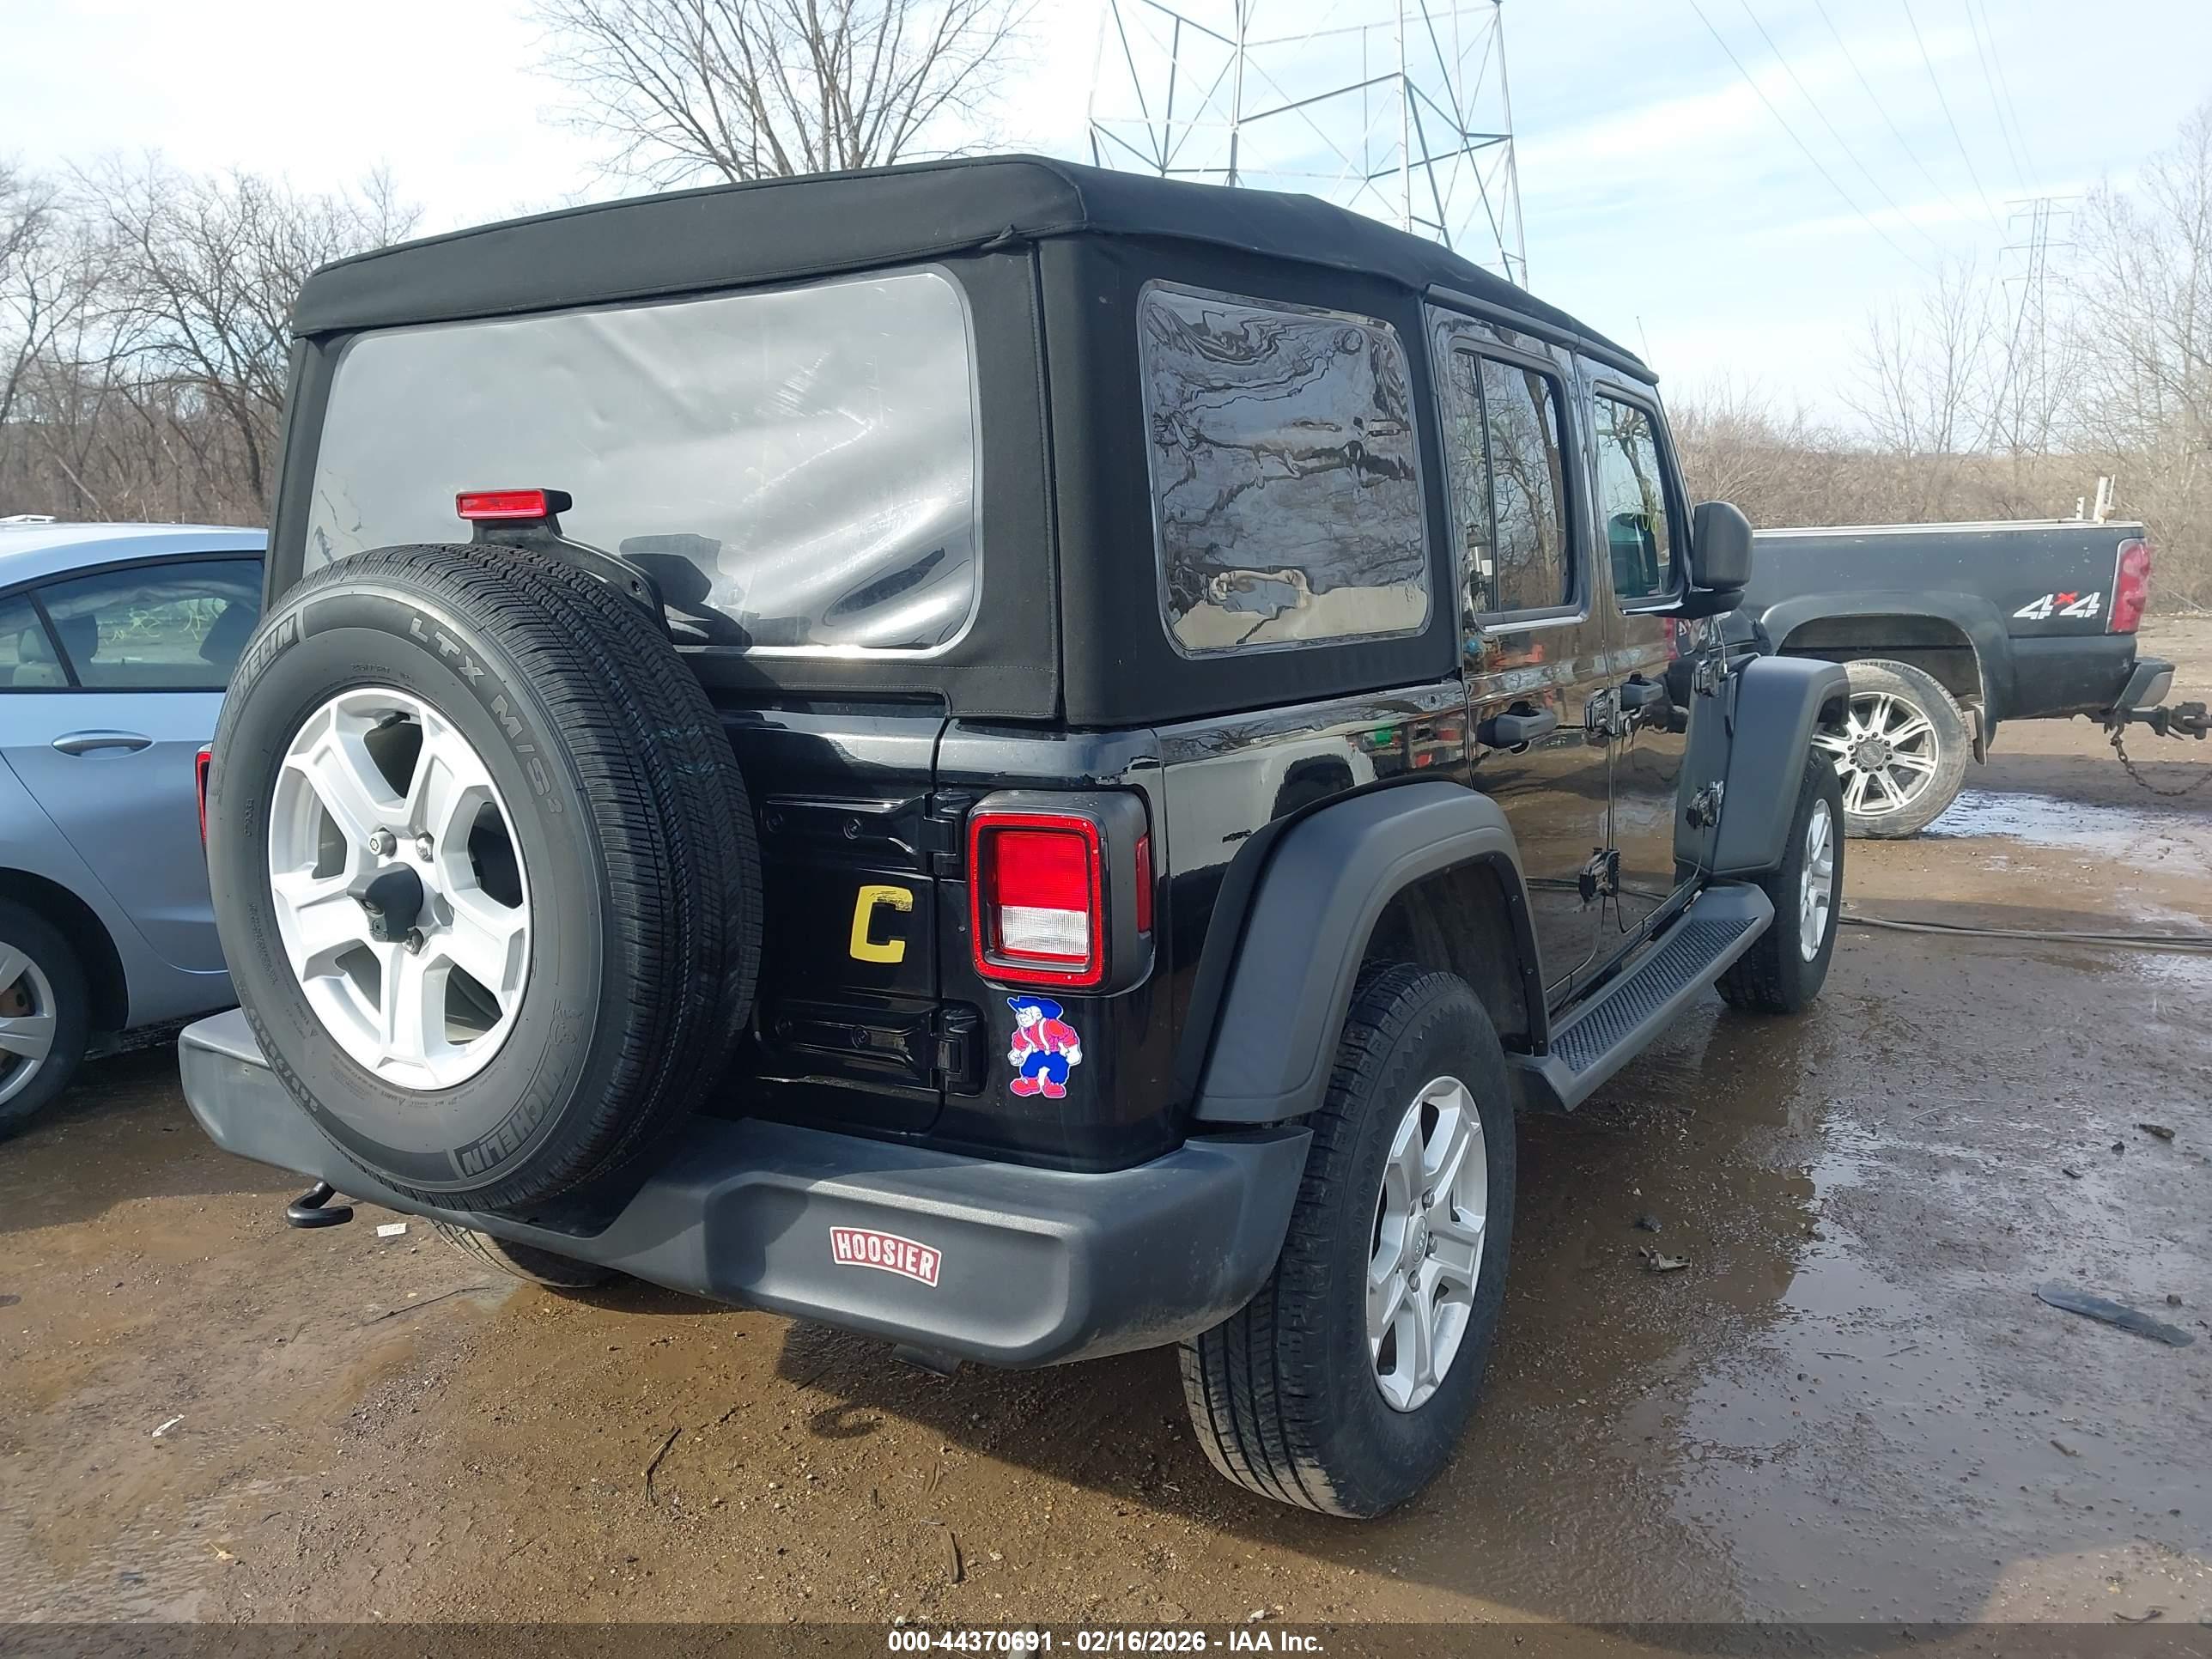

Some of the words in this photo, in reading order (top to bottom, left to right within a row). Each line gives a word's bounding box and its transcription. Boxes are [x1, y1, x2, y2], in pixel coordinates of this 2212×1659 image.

[408, 617, 487, 688] LTX
[849, 884, 915, 963] C
[461, 1058, 569, 1177] MICHELIN
[835, 1231, 936, 1280] HOOSIER
